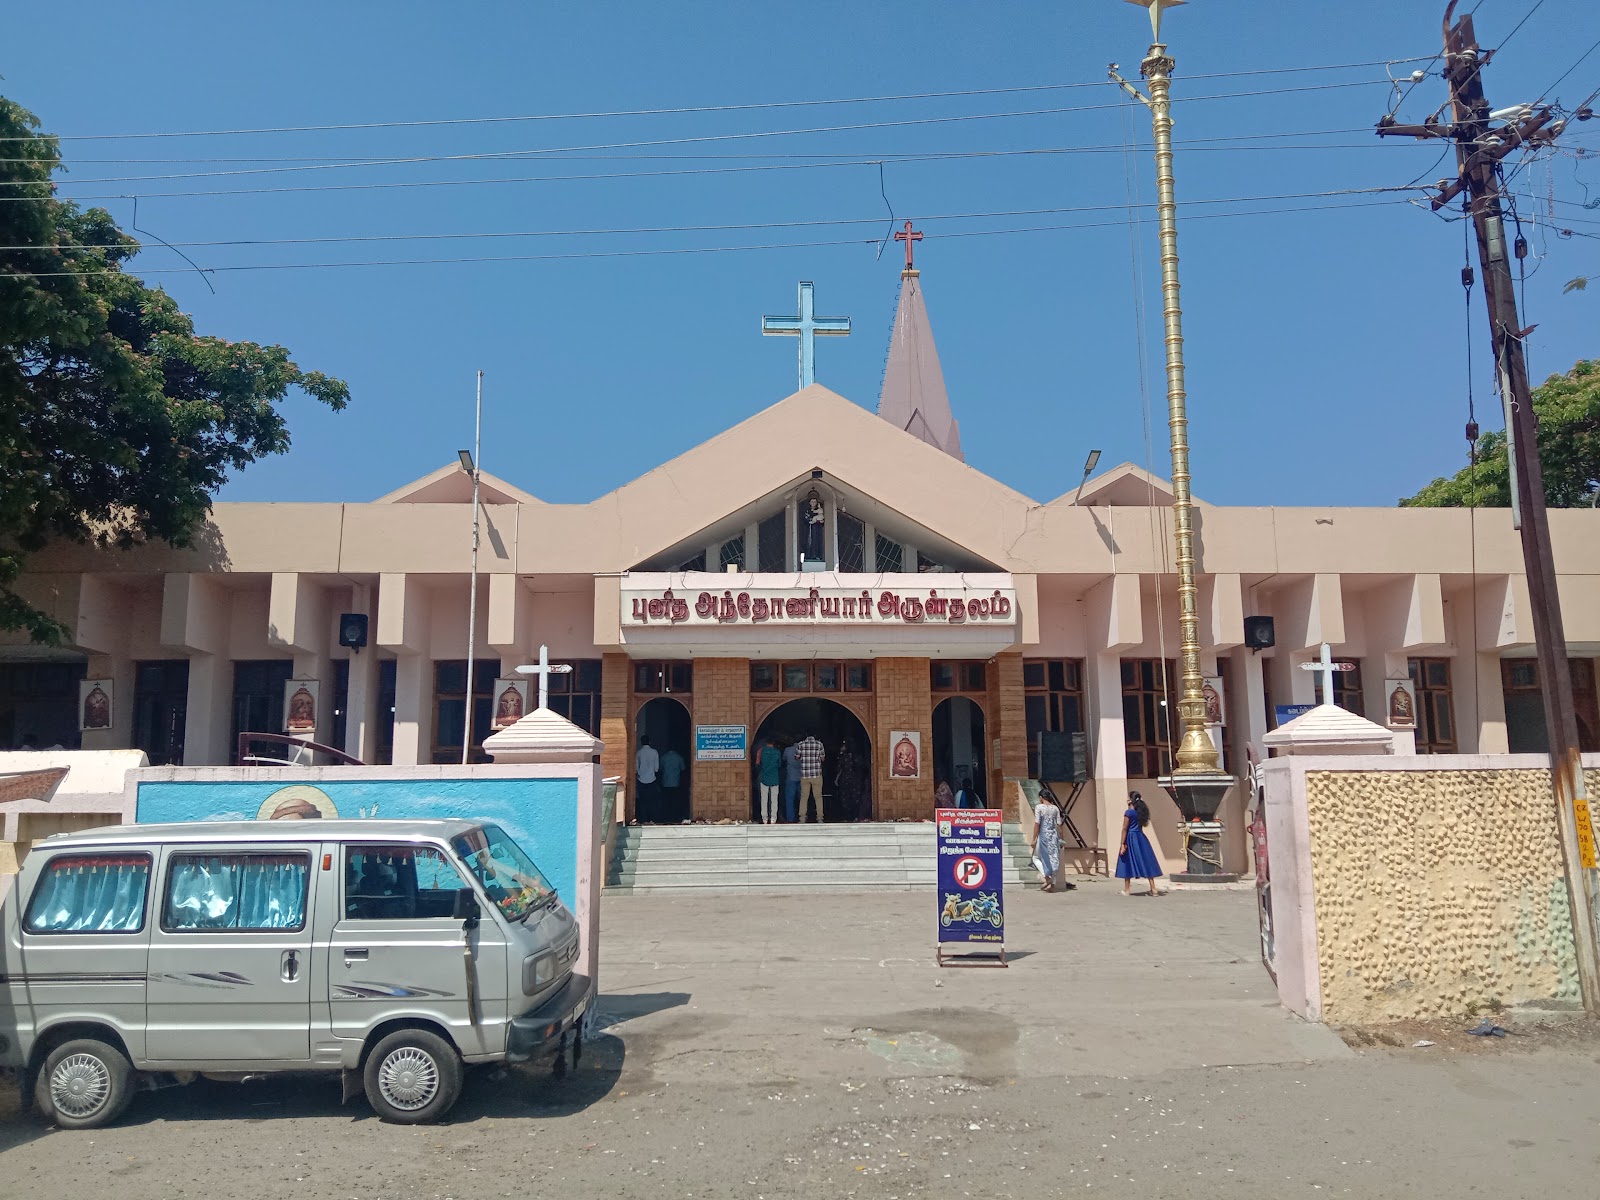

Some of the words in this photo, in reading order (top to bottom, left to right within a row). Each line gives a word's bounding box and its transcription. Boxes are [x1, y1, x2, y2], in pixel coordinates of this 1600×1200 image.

[632, 589, 690, 624] புனித
[695, 588, 874, 624] அந்தோணியார்
[877, 589, 1012, 624] அருள்தலம்
[1582, 844, 1588, 852] 2
